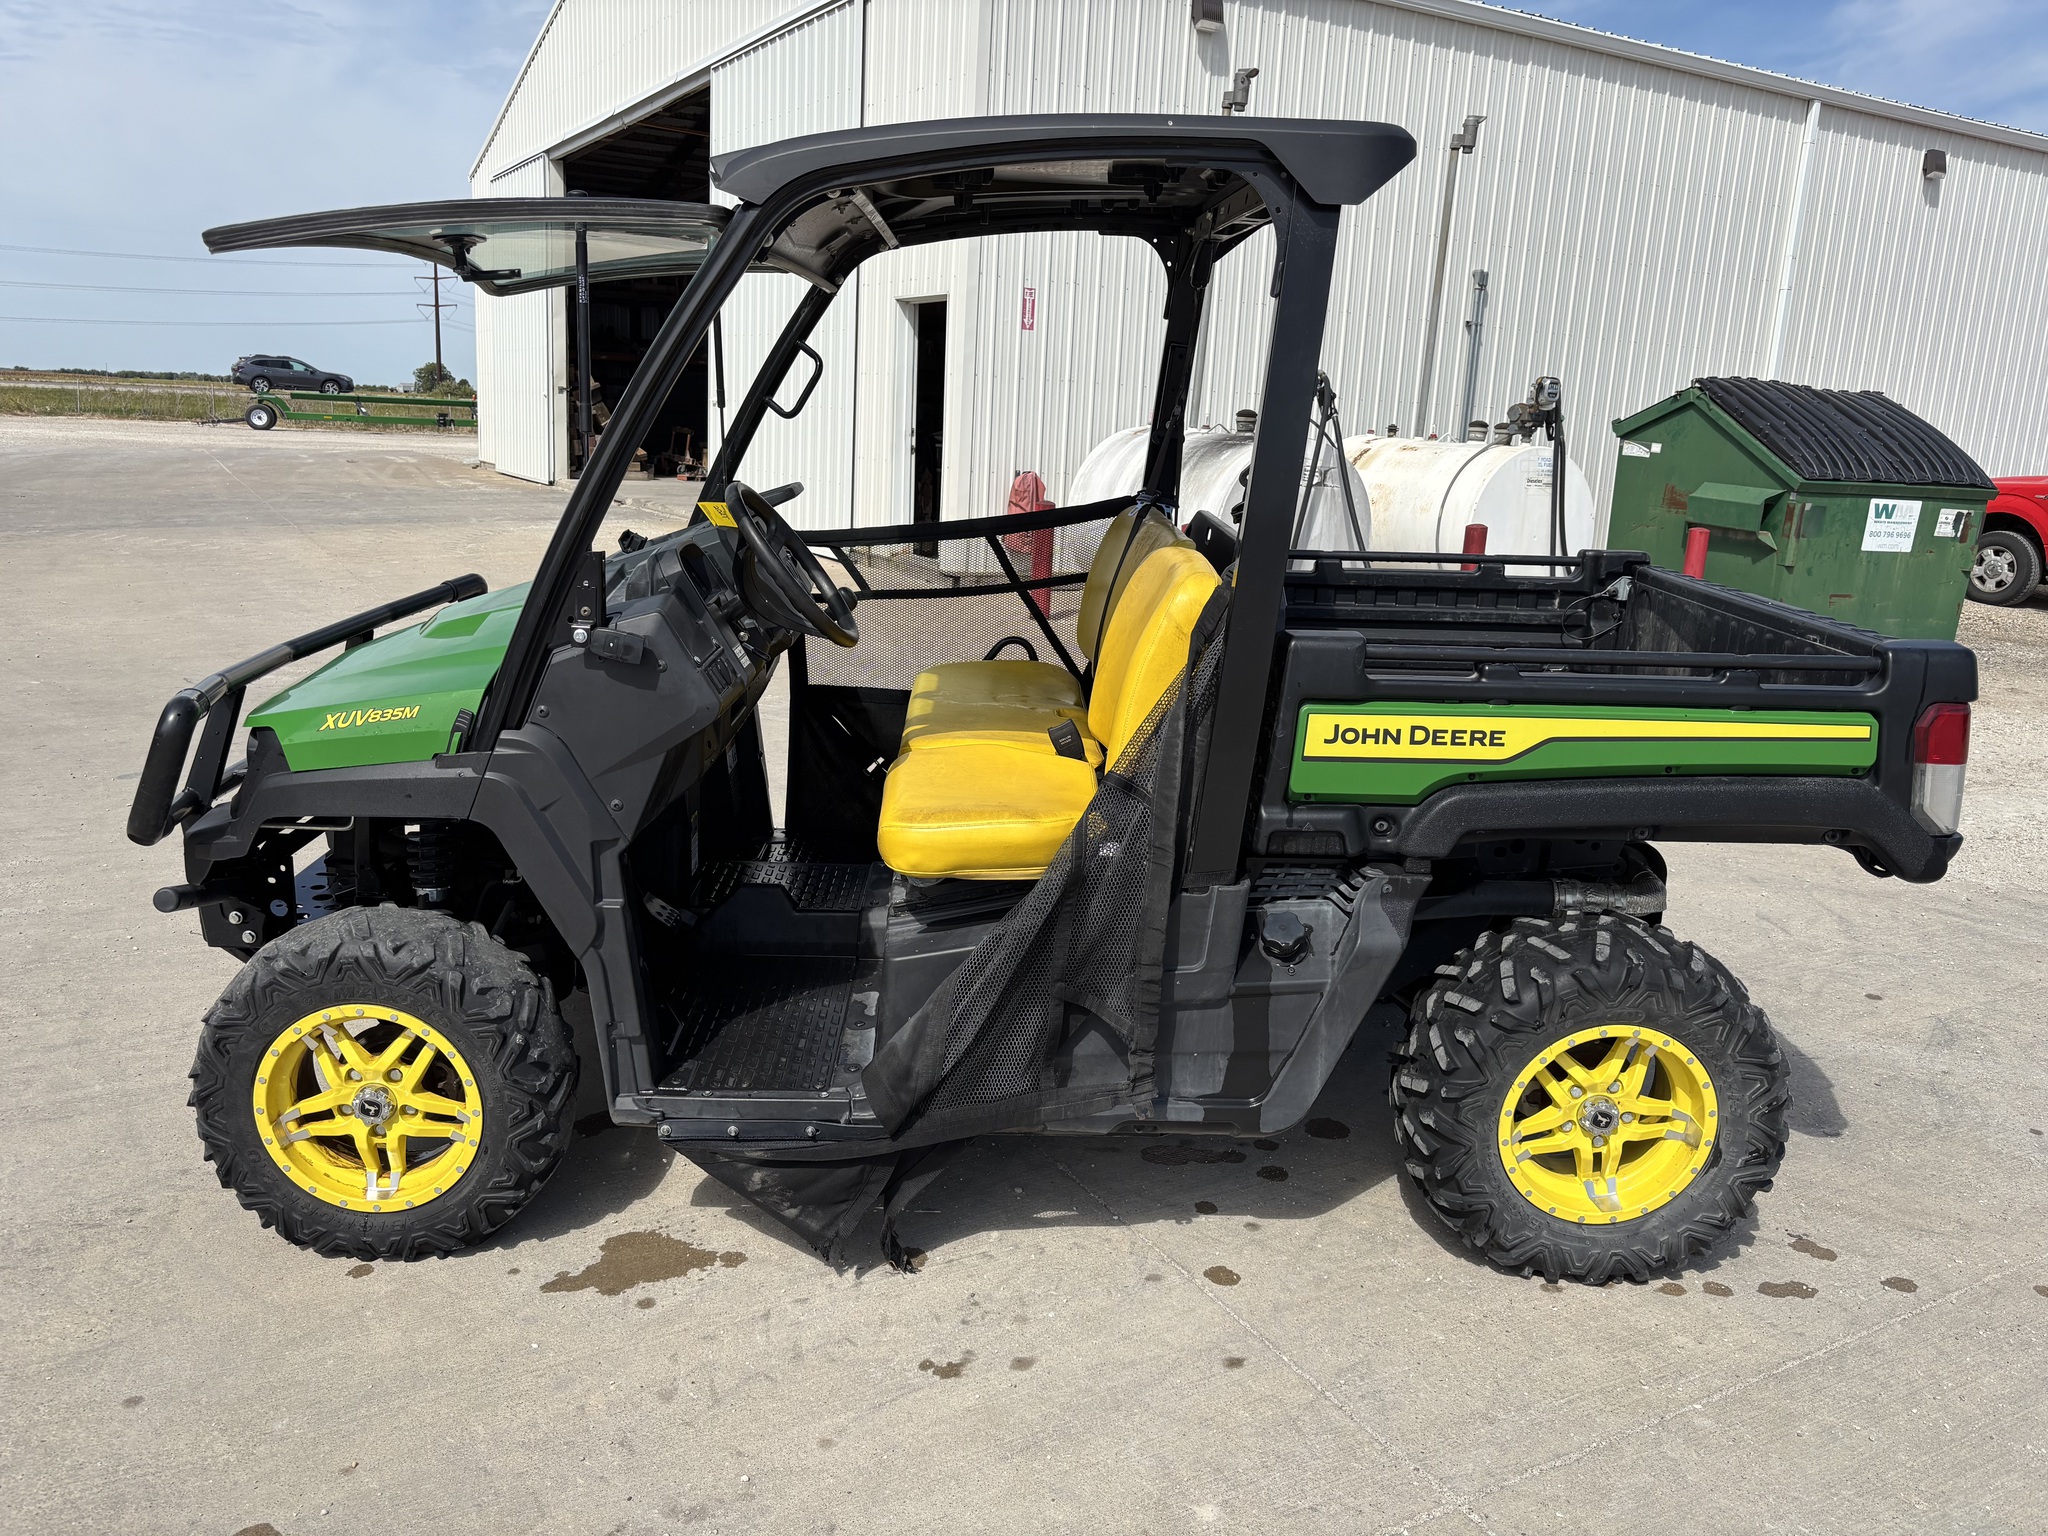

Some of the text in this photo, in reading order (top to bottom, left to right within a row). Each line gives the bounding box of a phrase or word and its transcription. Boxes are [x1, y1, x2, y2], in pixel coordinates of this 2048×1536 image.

[1869, 530, 1911, 539] 800 796 9696
[317, 704, 420, 731] XUV835M
[1323, 724, 1506, 747] JOHN DEERE
